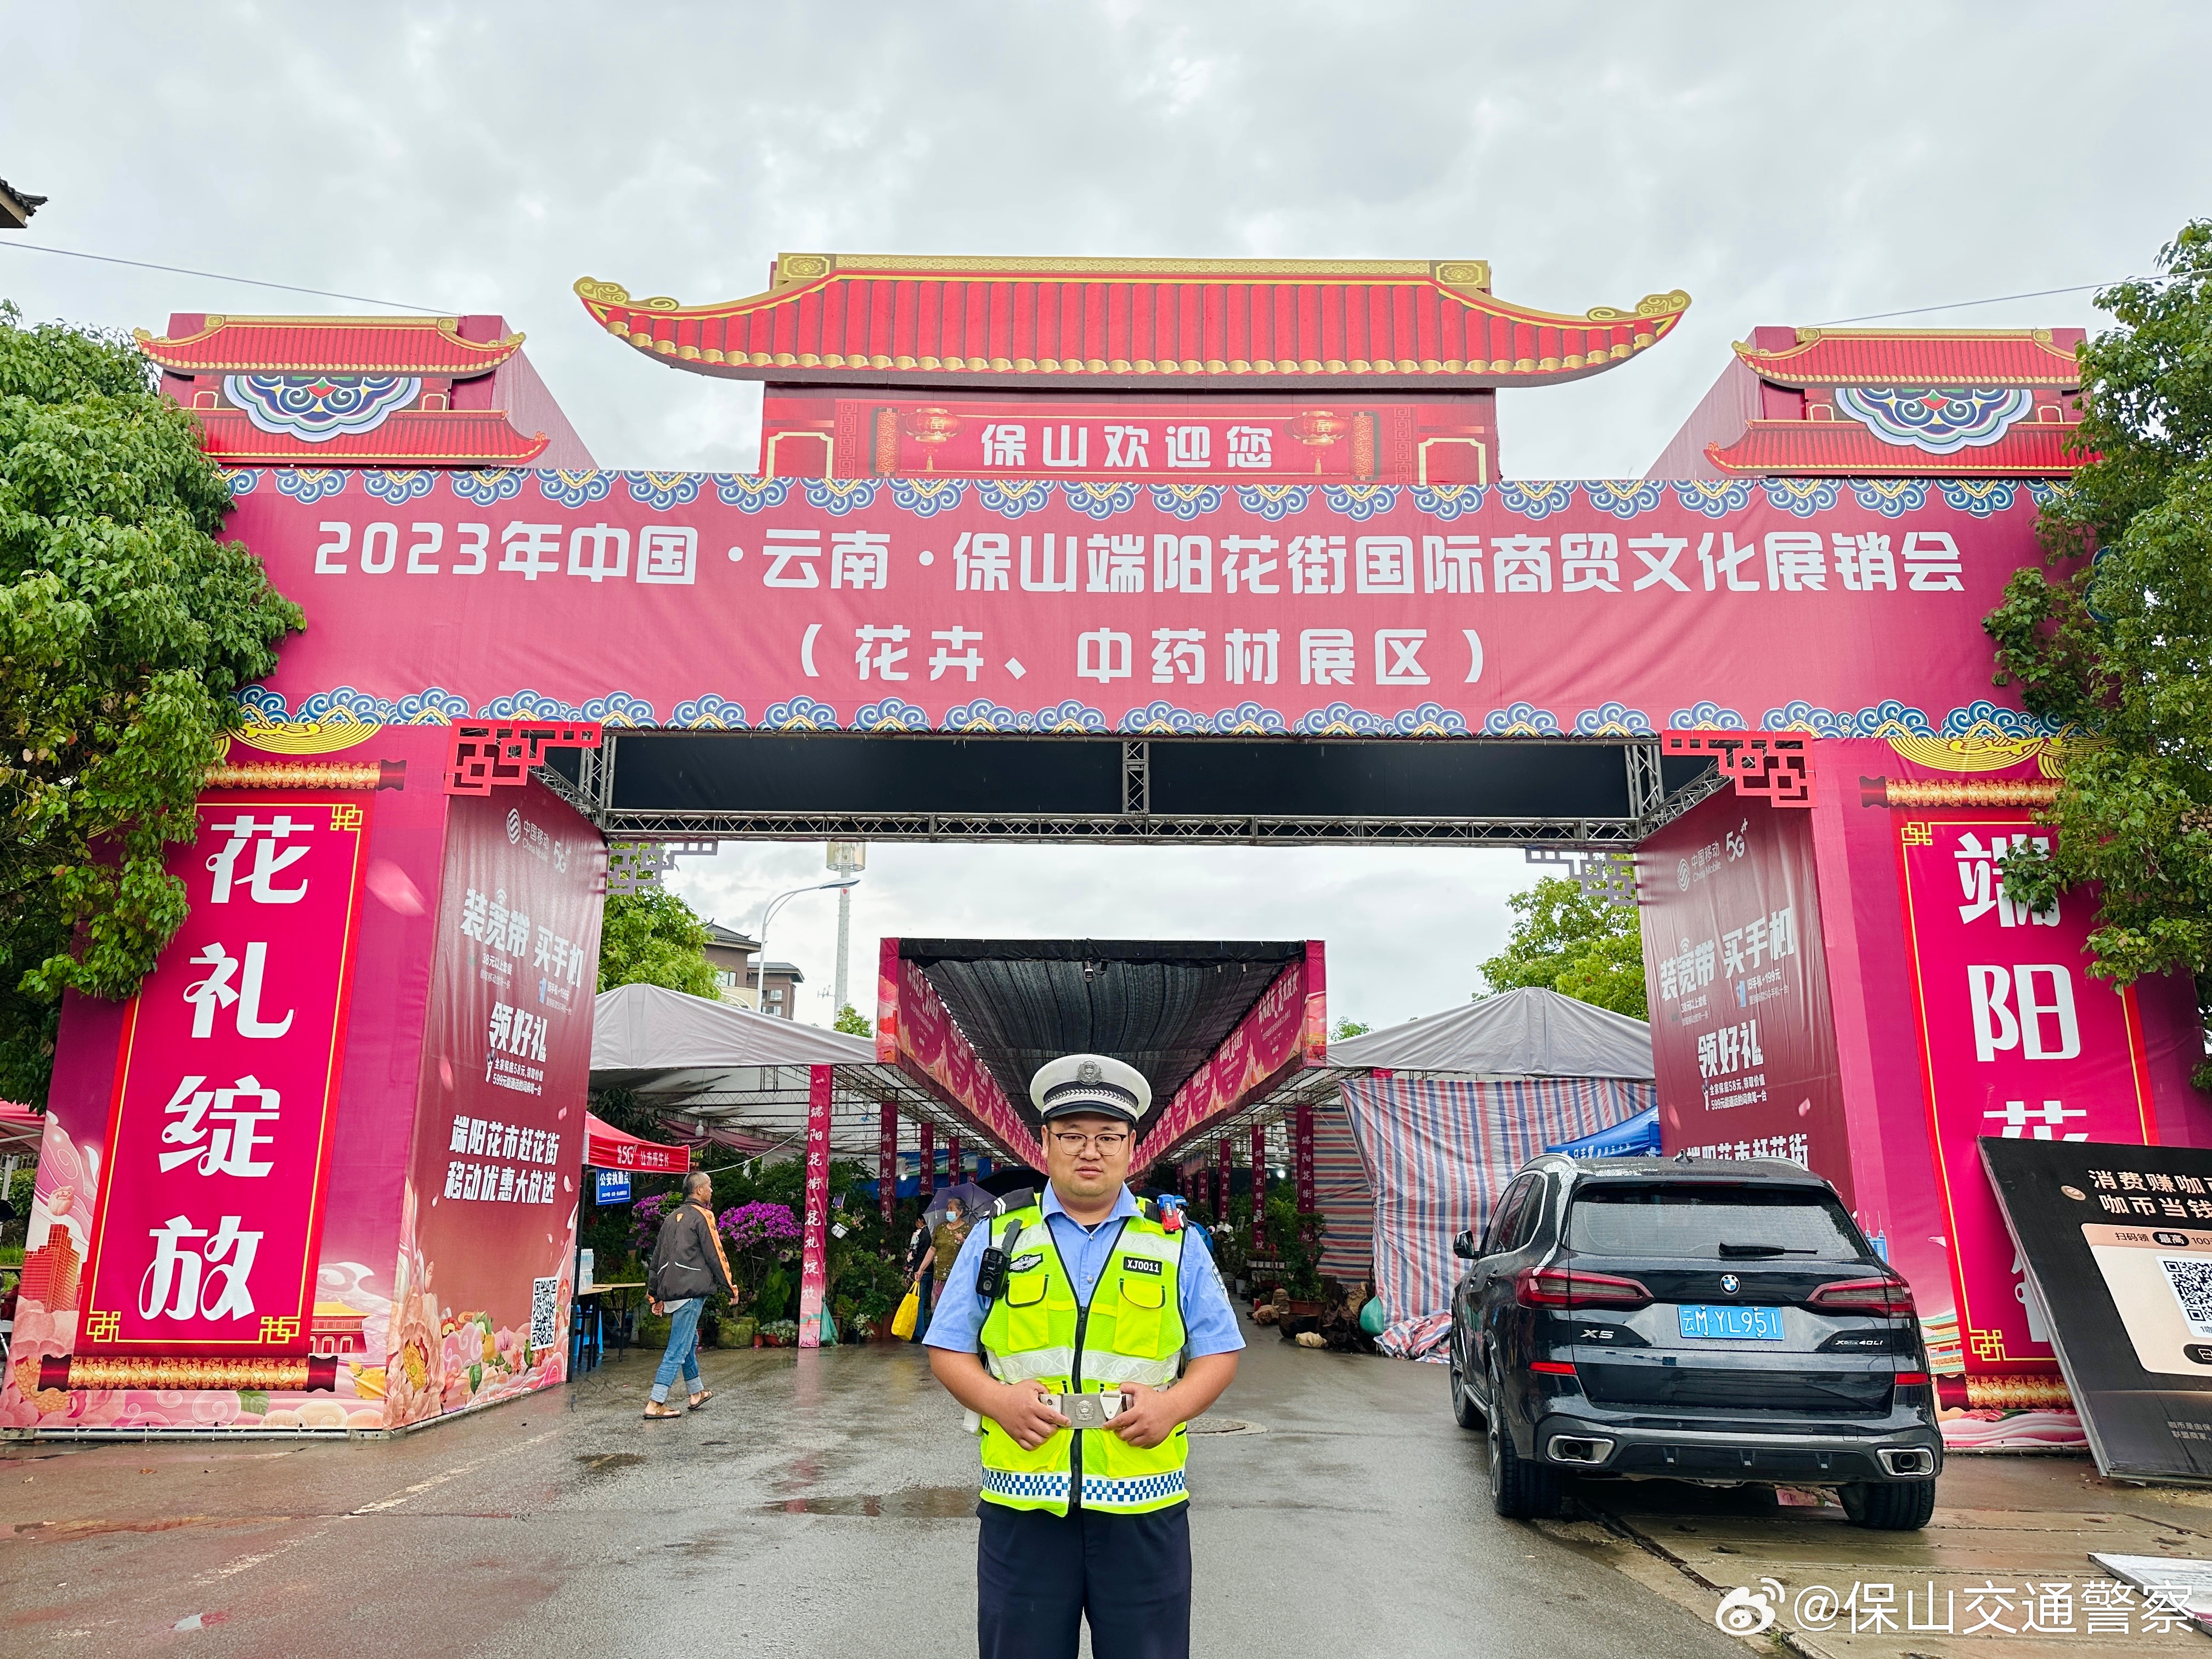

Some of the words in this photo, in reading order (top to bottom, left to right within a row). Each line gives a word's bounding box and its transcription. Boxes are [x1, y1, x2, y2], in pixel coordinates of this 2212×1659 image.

[980, 424, 1273, 469] 保山欢迎您
[523, 819, 549, 850] 中国移动
[1691, 840, 1720, 870] 中国移动
[460, 888, 530, 958] 装宽带
[533, 924, 584, 988] 买手机
[1660, 939, 1716, 1002] 装宽带
[1722, 906, 1795, 979] 买手机
[488, 1001, 548, 1063] 领好礼
[1698, 1019, 1764, 1079] 领好礼
[138, 815, 314, 1321] 花礼绽放
[449, 1114, 560, 1166] 端阳花市赶花街
[443, 1161, 556, 1204] 移动优惠大放送
[802, 1104, 825, 1300] 端阳花街·花礼绽放
[2087, 1170, 2212, 1194] 消费赚咖
[2115, 1232, 2150, 1243] 扫码领
[2158, 1233, 2185, 1245] 最高
[2191, 1237, 2212, 1245] 100
[1127, 1259, 1160, 1273] XJ0011
[1580, 1329, 1614, 1339] X5
